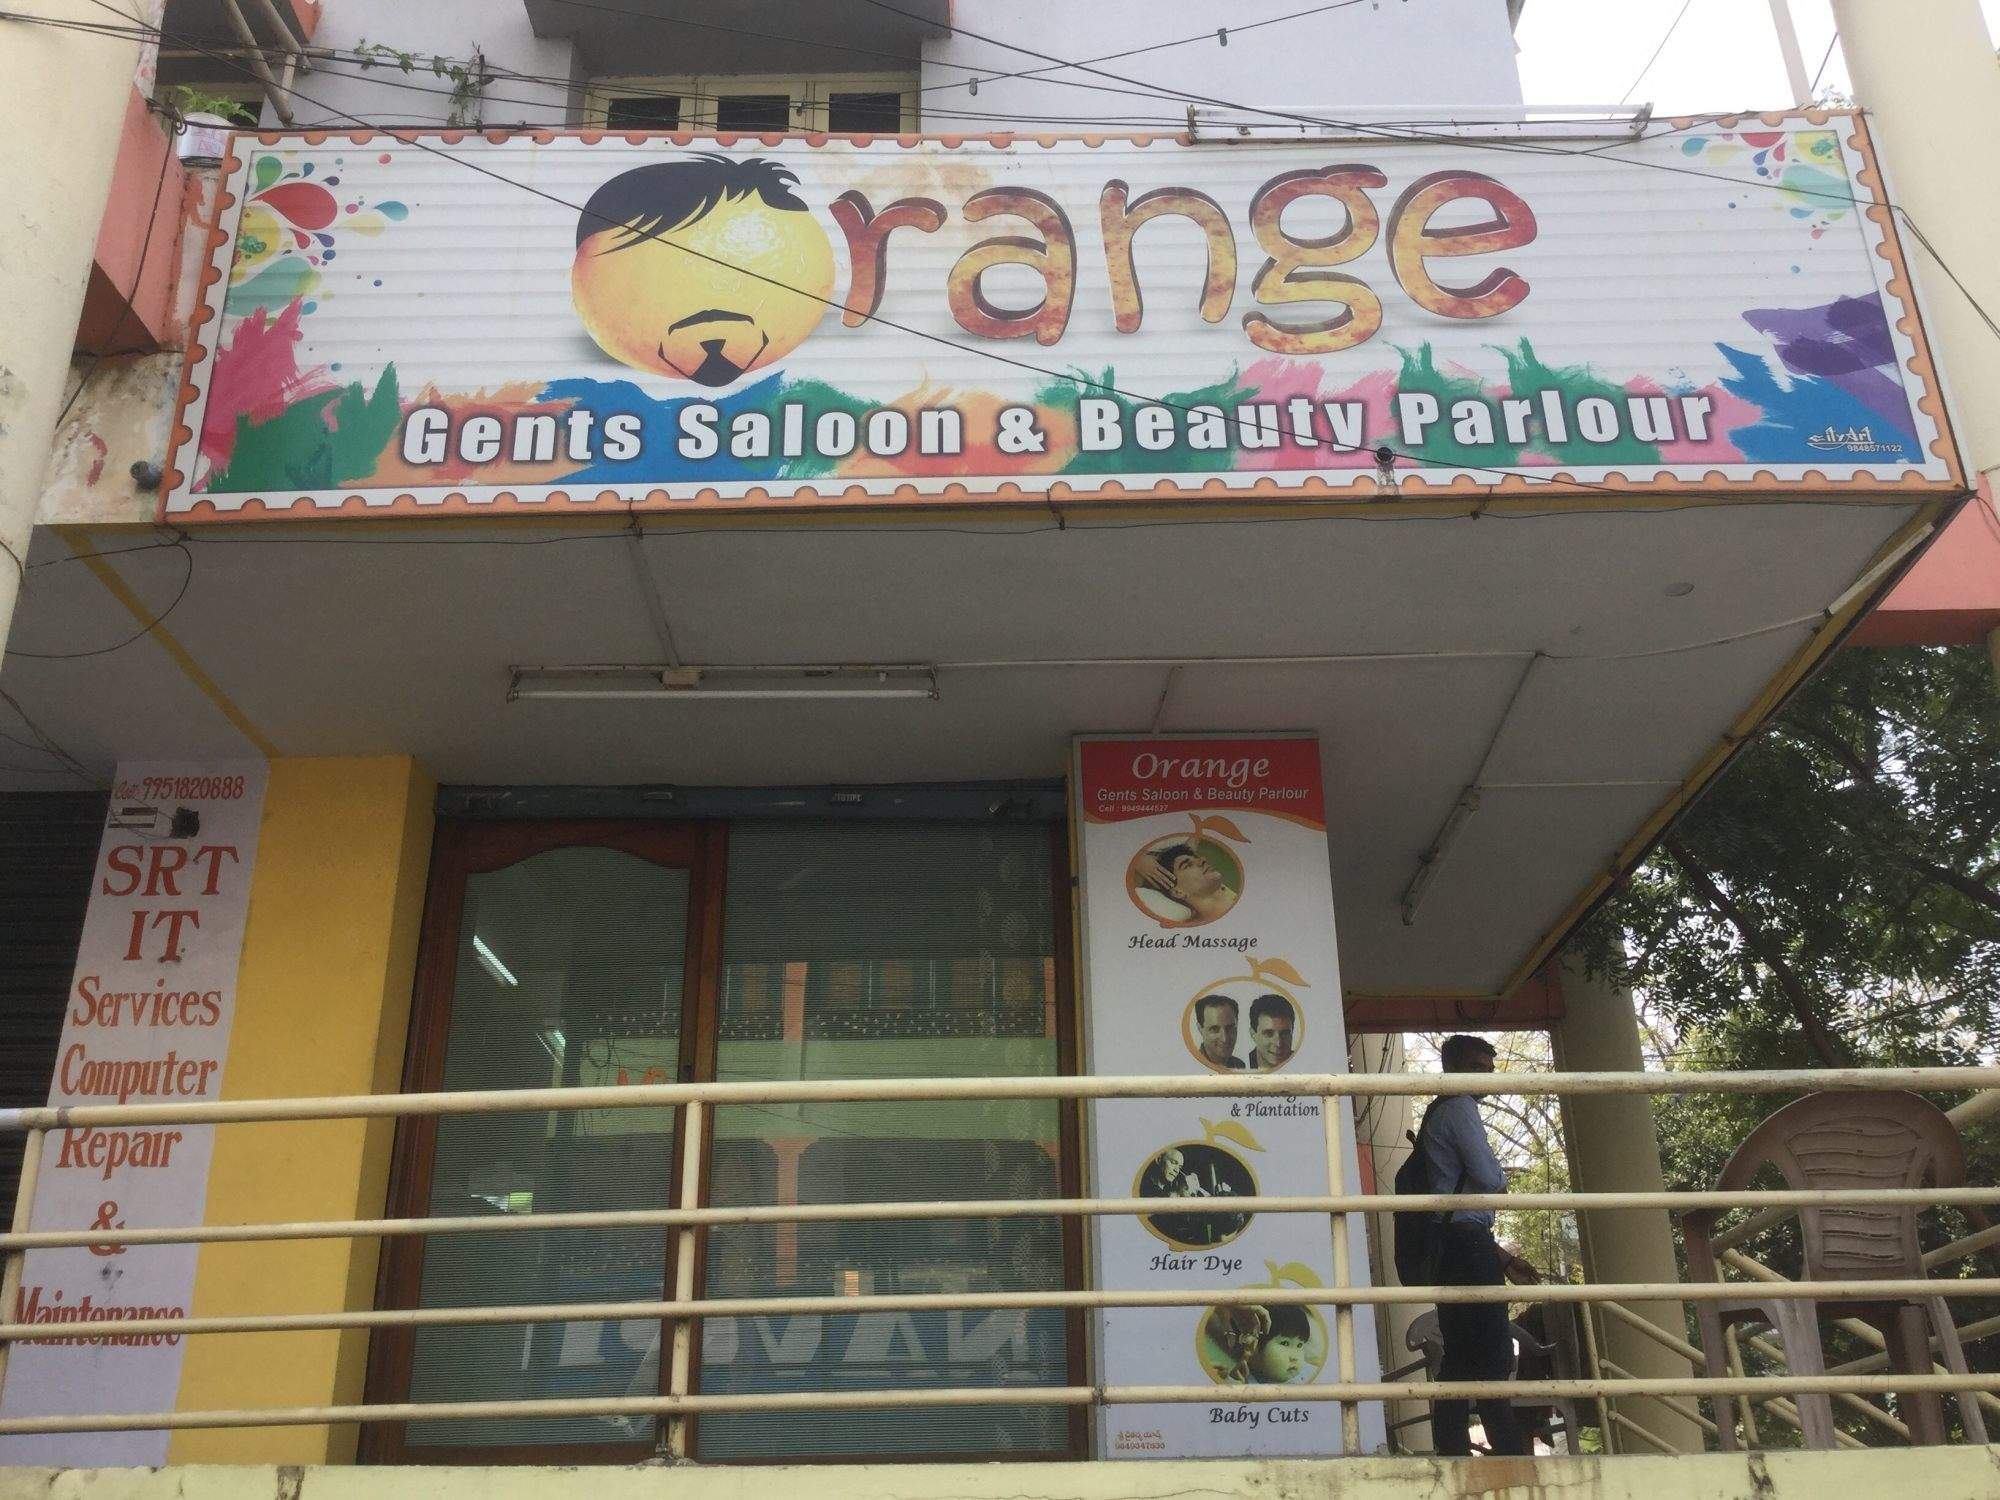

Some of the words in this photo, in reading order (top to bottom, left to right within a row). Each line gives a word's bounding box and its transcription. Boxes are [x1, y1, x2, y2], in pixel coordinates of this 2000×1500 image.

[402, 407, 642, 464] Gents
[677, 403, 962, 459] Saloon
[998, 402, 1047, 454] &
[1080, 397, 1365, 453] Beauty
[1399, 389, 1714, 447] Parlour
[1131, 753, 1270, 788] Orange
[142, 775, 245, 800] 9951820888
[1097, 788, 1137, 801] Gents
[1142, 787, 1188, 800] Saloon
[1193, 788, 1203, 799] &
[1207, 787, 1254, 803] Beauty
[1259, 786, 1309, 799] Parlour
[102, 845, 240, 896] SRT
[123, 910, 200, 962] IT
[1128, 933, 1178, 949] Head
[1183, 935, 1258, 953] Massage
[72, 976, 222, 1027] Services
[61, 1043, 218, 1104] Computer
[1230, 1104, 1241, 1117] &
[1245, 1101, 1320, 1117] Plantation
[1150, 1253, 1197, 1270] Hair
[1204, 1257, 1243, 1275] Dye
[1209, 1405, 1260, 1429] Baby
[1267, 1407, 1309, 1423] Cuts
